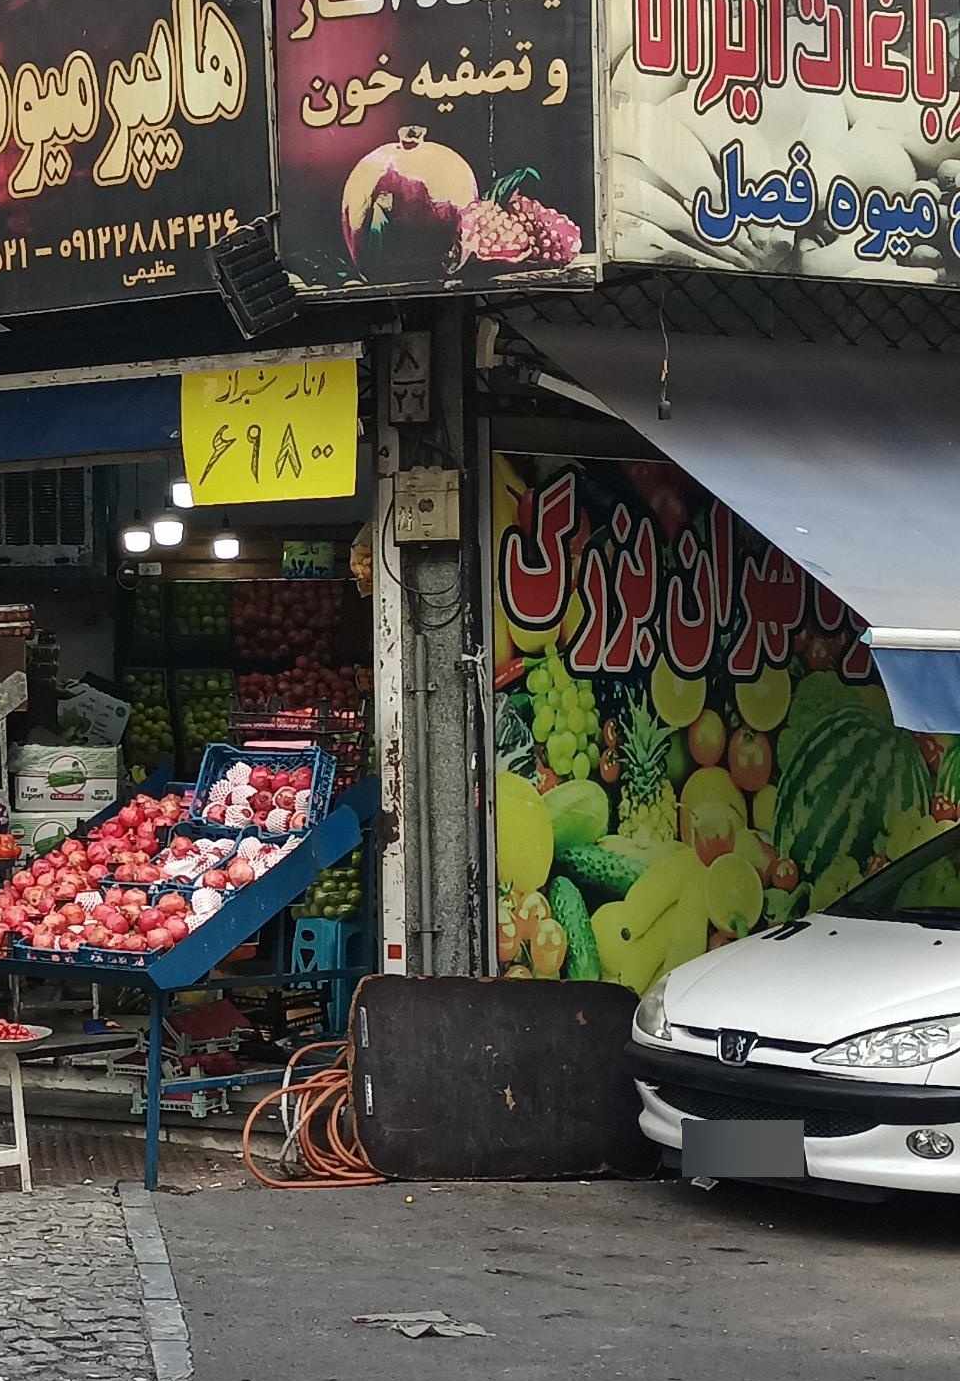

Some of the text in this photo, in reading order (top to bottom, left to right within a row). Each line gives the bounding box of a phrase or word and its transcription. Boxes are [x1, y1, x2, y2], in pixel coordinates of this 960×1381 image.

[300, 40, 569, 128] و تصفیه خون
[692, 139, 819, 245] فصل
[826, 173, 939, 261] میوه
[121, 259, 176, 287] عظیمی
[285, 362, 326, 400] انار
[198, 422, 335, 486] ۶۹۸۰۰
[505, 471, 657, 673] بزرگ
[26, 785, 39, 793] For
